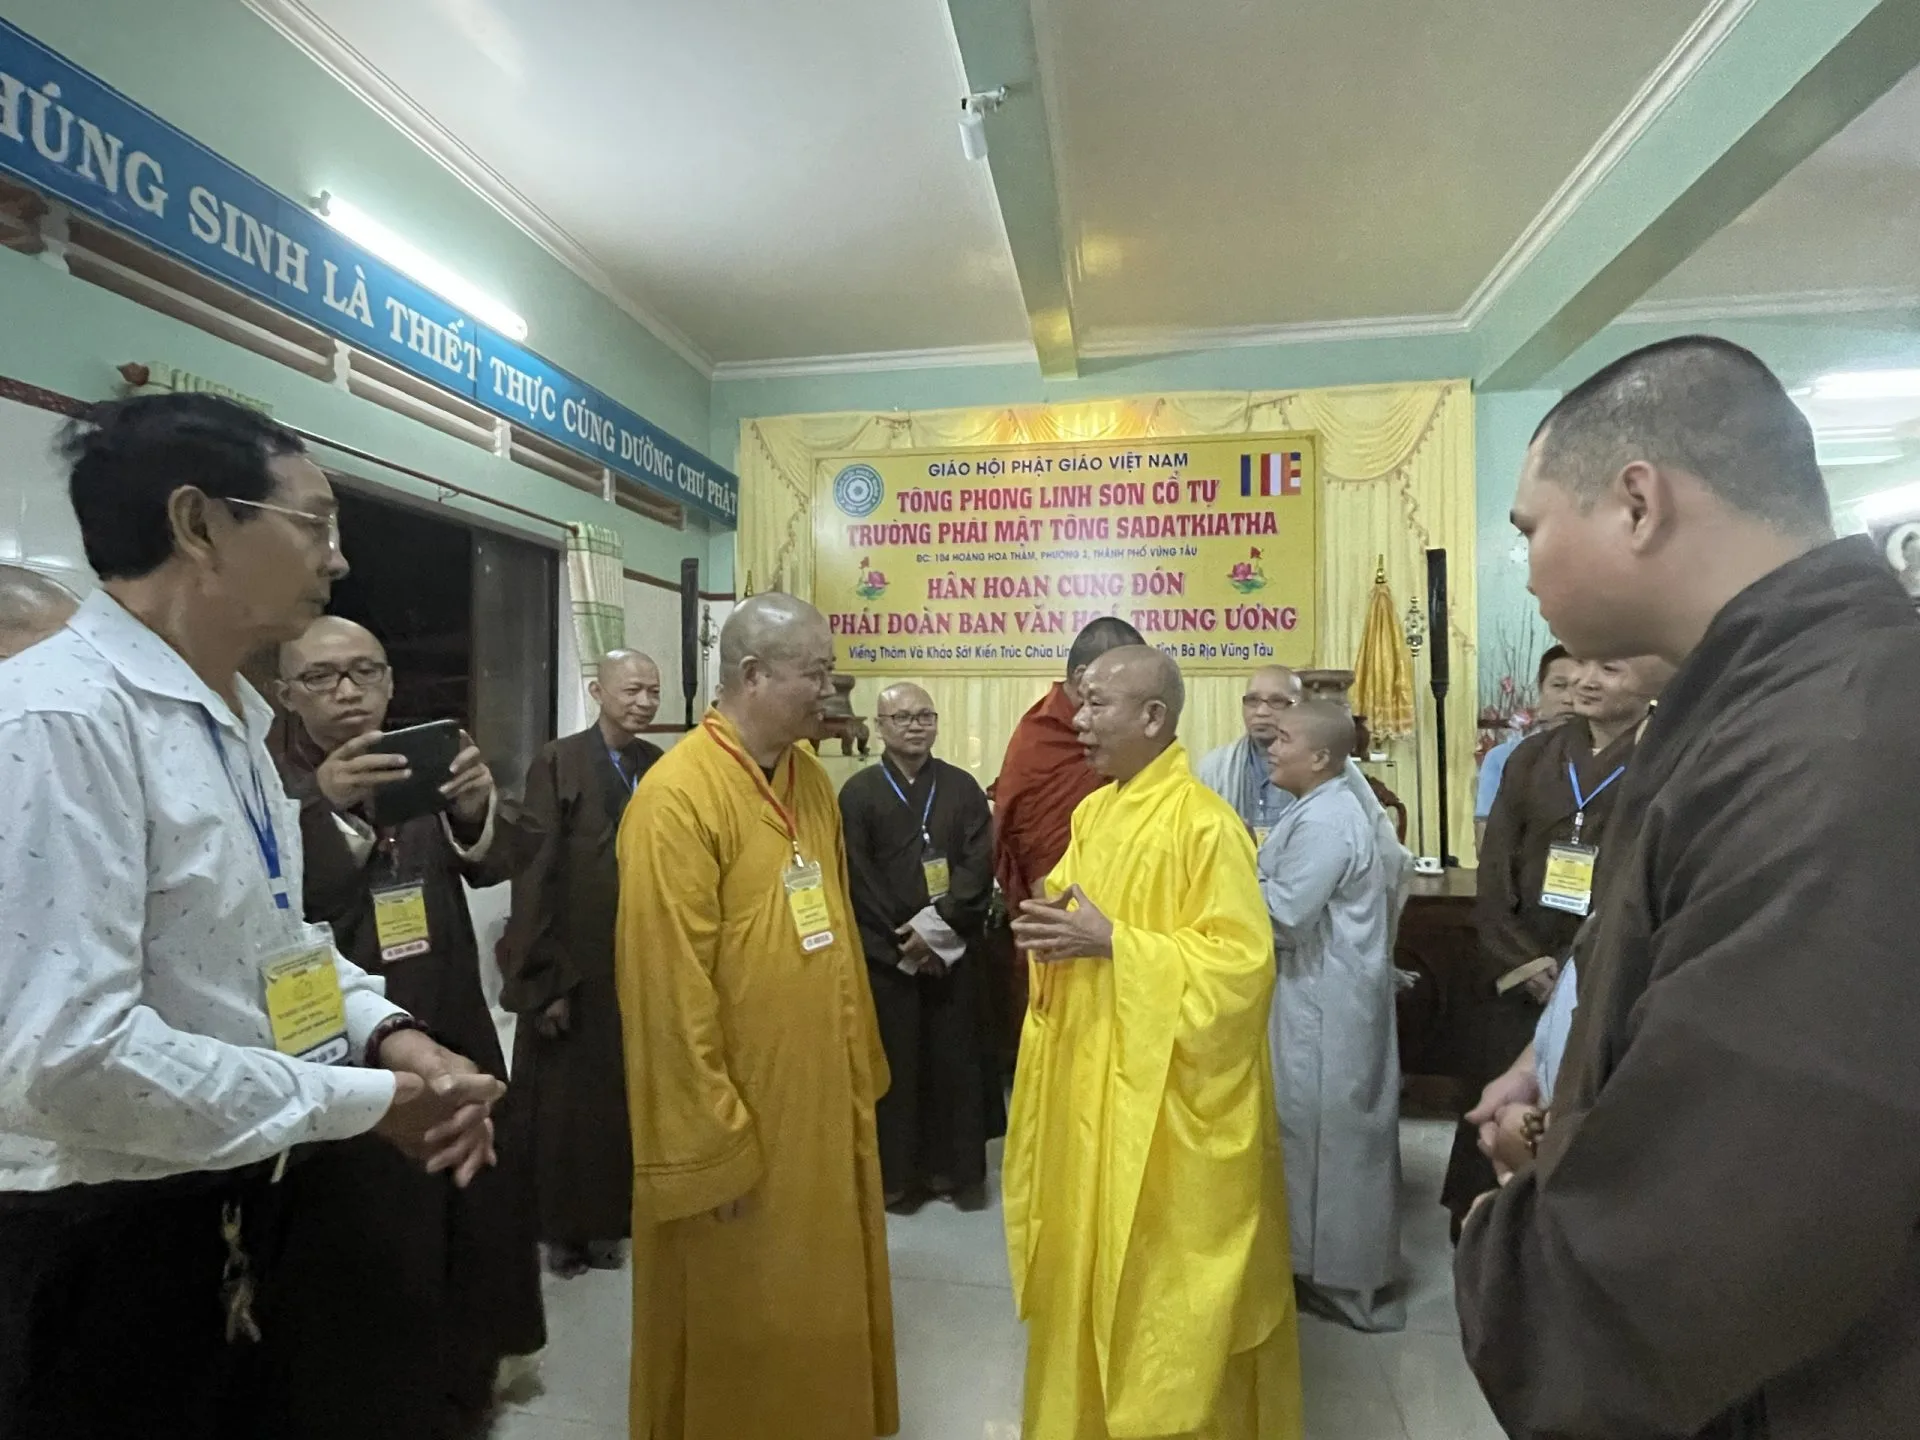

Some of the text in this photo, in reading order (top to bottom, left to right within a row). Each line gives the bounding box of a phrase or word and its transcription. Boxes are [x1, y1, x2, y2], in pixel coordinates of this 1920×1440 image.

[189, 186, 310, 293] SINH
[323, 258, 374, 328] LÀ
[385, 296, 482, 382] THIẾT
[489, 356, 556, 422] THỰC
[563, 398, 615, 453] CÚNG
[620, 429, 673, 482] DƯỜNG
[677, 462, 705, 499] CHƯ
[708, 479, 737, 517] PHẬT
[928, 451, 1188, 478] GIÁO HỘI PHẬT GIÁO VIỆT NAM
[896, 486, 952, 513] TÔNG
[960, 487, 1033, 511] PHONG
[1039, 484, 1092, 509] LINH
[1152, 470, 1180, 505] CỔ
[1187, 479, 1220, 509] TỰ
[994, 515, 1043, 547] MẬT
[1050, 513, 1109, 542] TÔNG
[1116, 511, 1278, 540] SADATKIATHA
[988, 551, 1007, 562] HOA
[927, 571, 977, 600] HÂN
[983, 574, 1051, 598] HOAN
[1132, 565, 1185, 596] ĐÓN
[829, 607, 882, 635] PHÁI
[887, 606, 953, 635] ĐOÀN
[959, 610, 1008, 635] BAN
[1014, 603, 1065, 634] VĂN
[1130, 608, 1218, 633] TRUNG
[1224, 603, 1297, 632] ƯƠNG
[849, 643, 876, 663] Viếng
